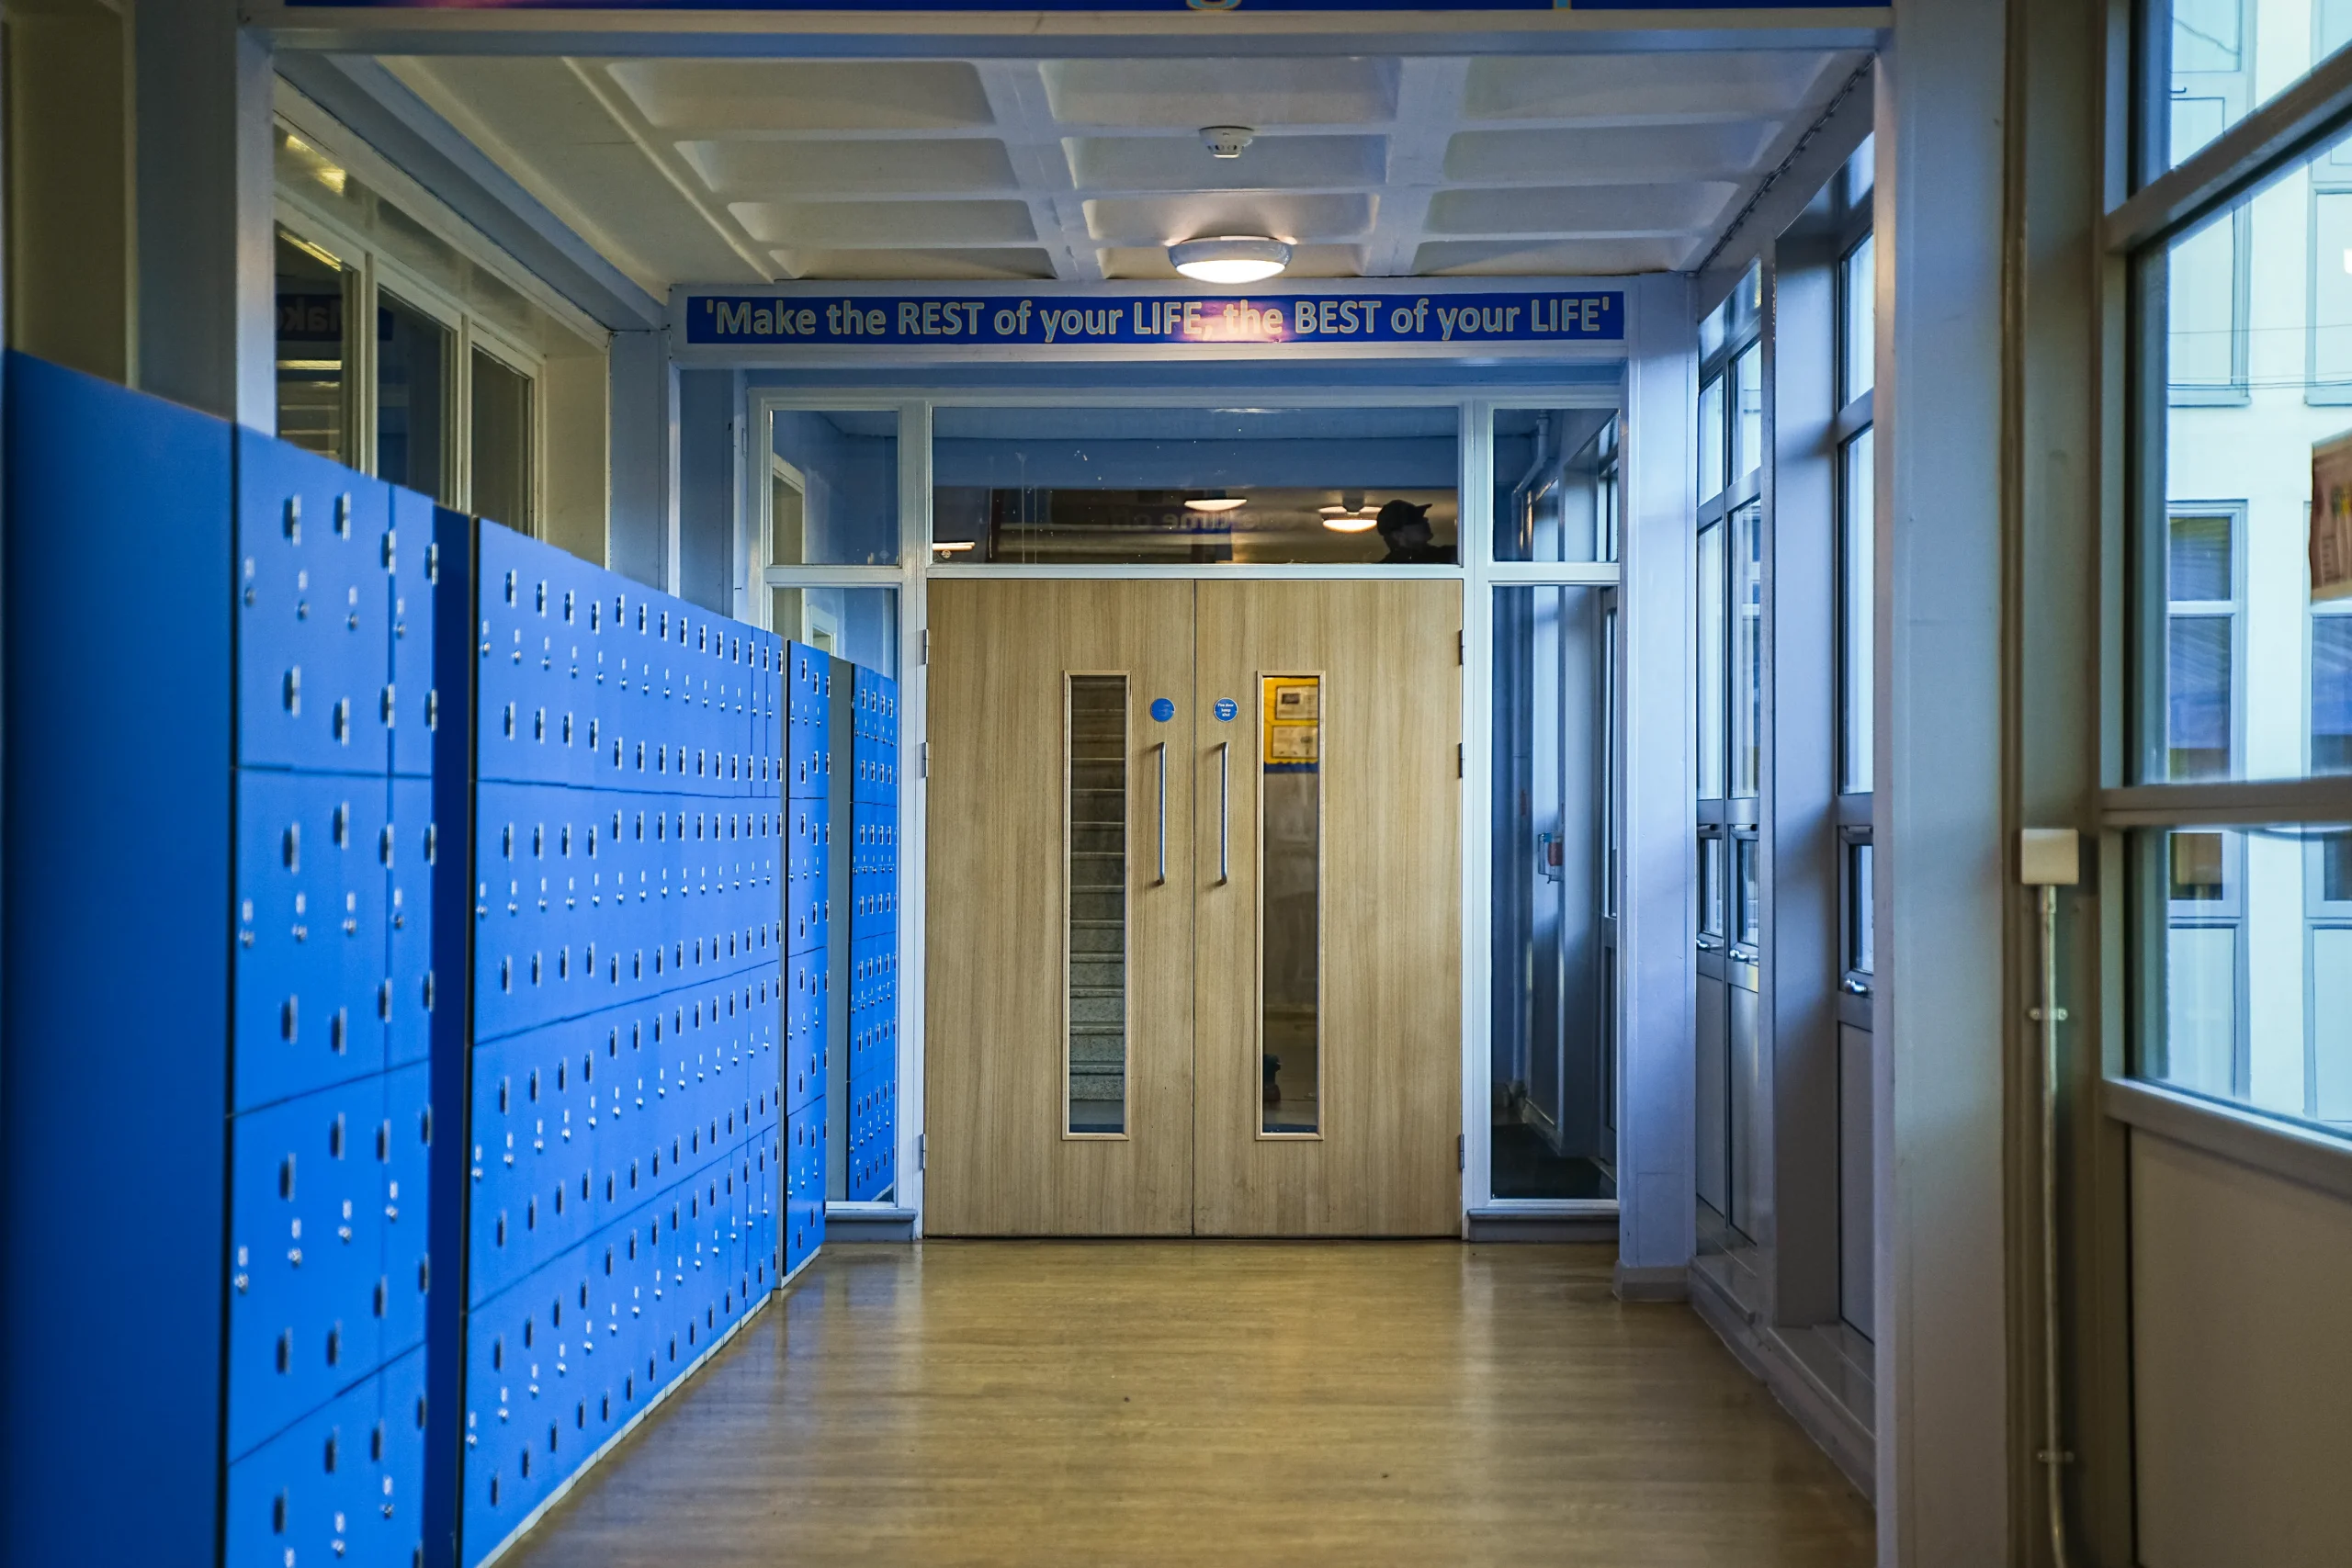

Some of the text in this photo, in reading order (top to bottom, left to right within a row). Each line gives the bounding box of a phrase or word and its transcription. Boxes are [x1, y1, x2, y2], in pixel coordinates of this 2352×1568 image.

[706, 297, 1611, 344] 'Make the REST of your LIFE, the BEST of your LIFE'
